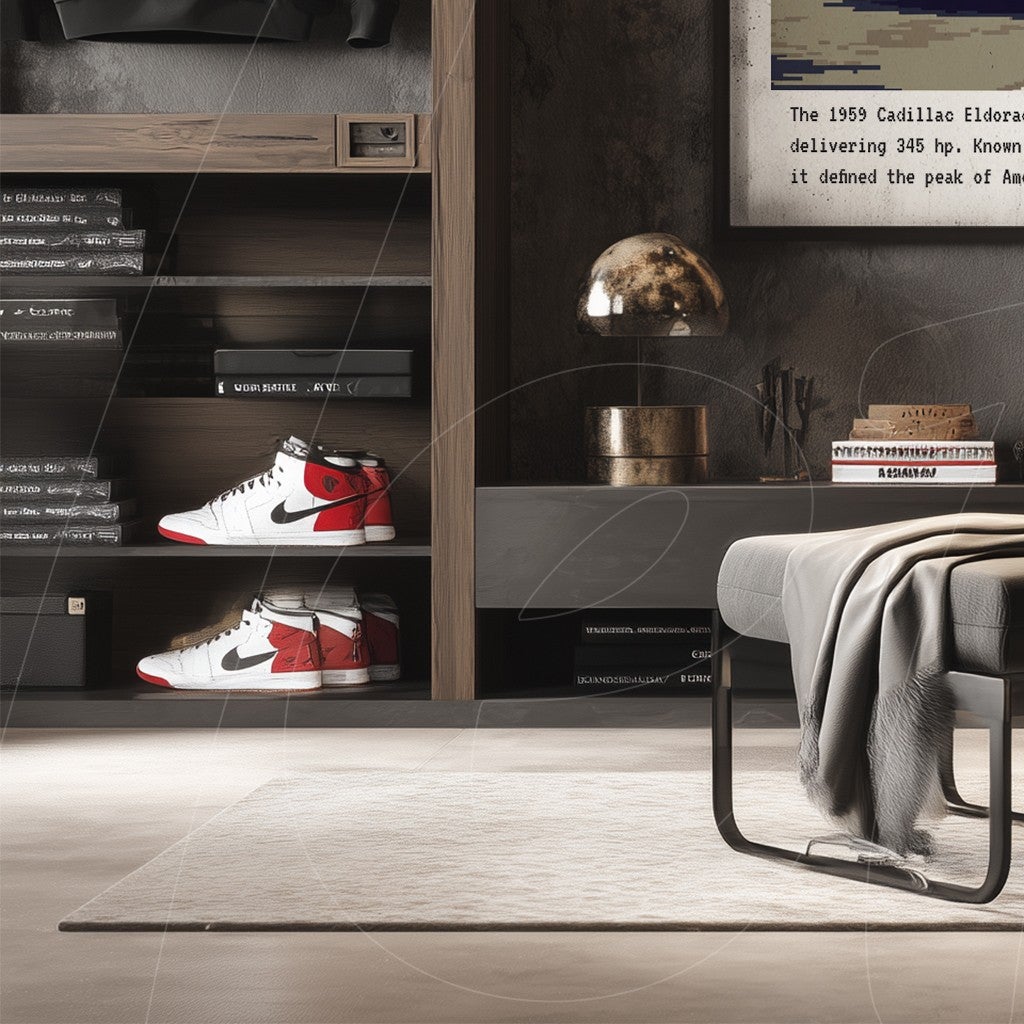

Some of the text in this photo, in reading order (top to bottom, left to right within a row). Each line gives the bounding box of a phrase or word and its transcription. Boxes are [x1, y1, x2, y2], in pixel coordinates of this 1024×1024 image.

[789, 106, 819, 122] The
[829, 106, 867, 122] 1959
[877, 106, 954, 122] Cadillac
[790, 137, 887, 157] delivering
[896, 137, 925, 153] 345
[934, 137, 963, 157] hp.
[973, 138, 1022, 154] Known
[791, 168, 808, 184] it
[819, 168, 877, 184] defined
[886, 168, 915, 184] the
[925, 168, 964, 188] peak
[973, 168, 992, 185] of
